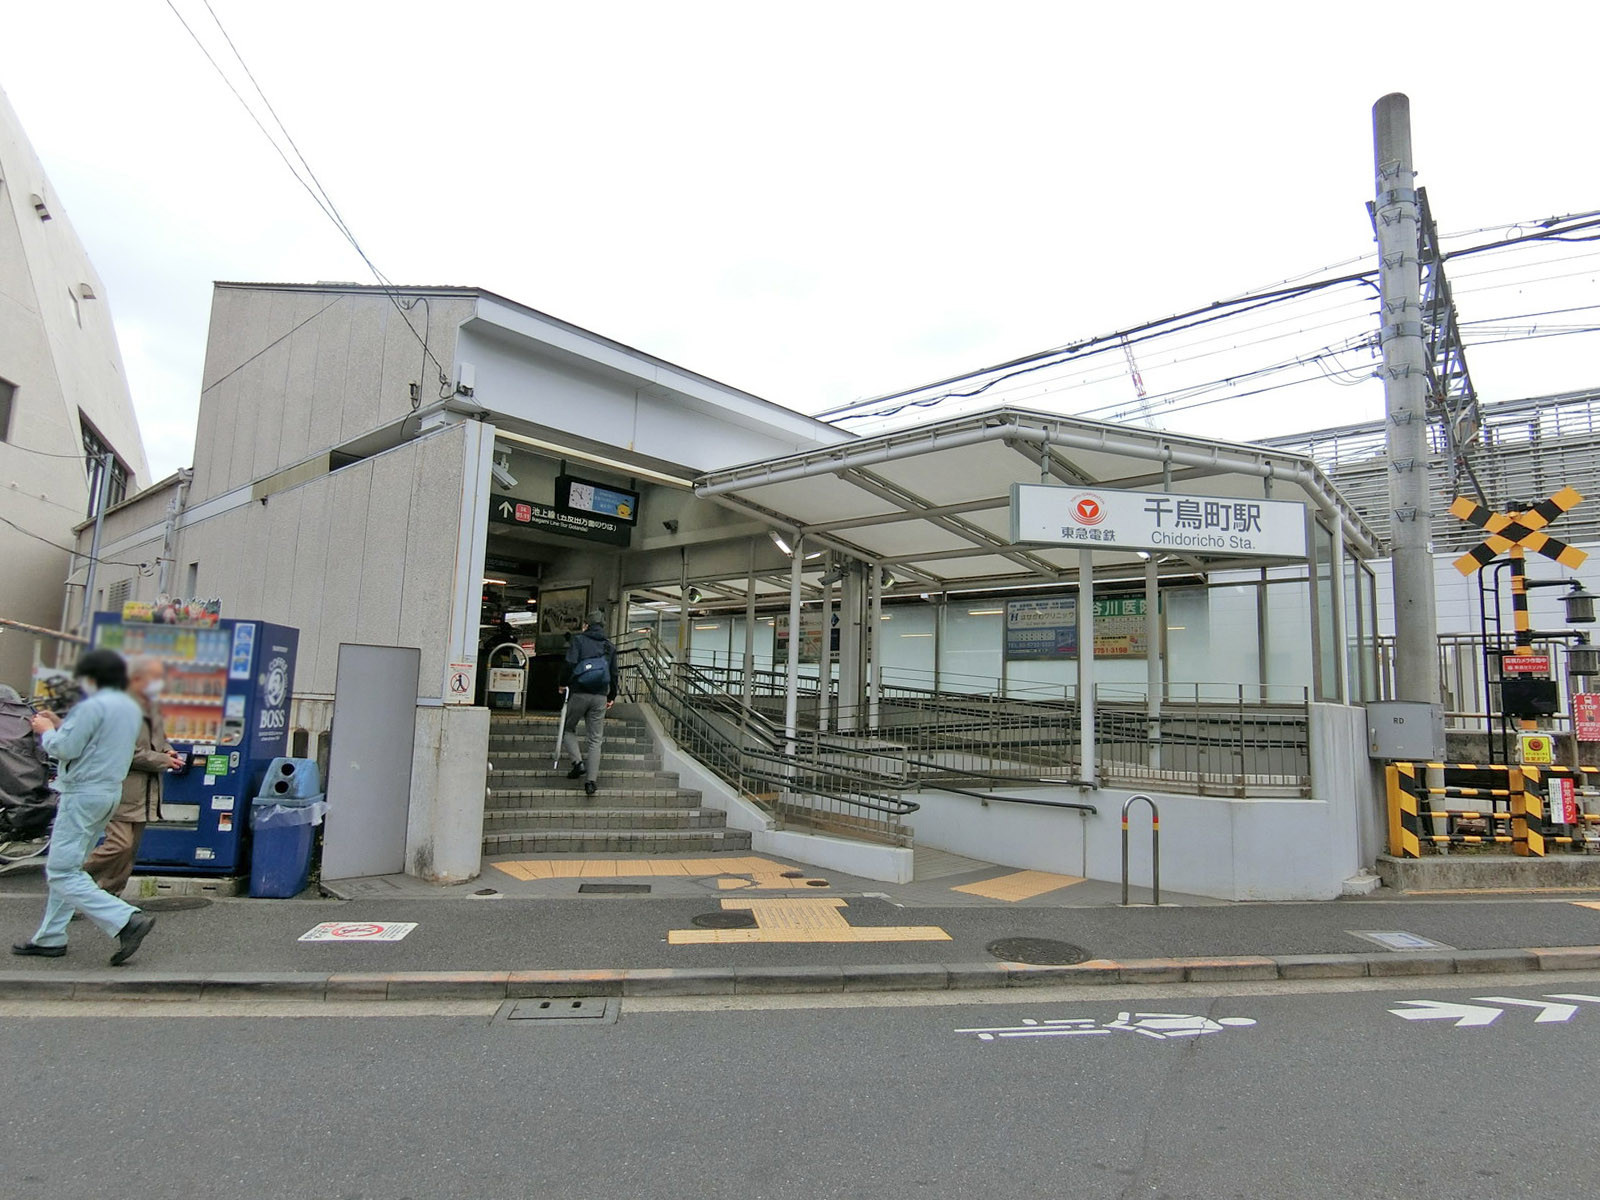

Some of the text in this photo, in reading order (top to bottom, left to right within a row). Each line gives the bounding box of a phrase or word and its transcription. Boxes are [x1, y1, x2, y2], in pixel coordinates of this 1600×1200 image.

[1143, 497, 1262, 533] 千鳥町駅
[1061, 526, 1116, 542] 東急電鉄
[1151, 530, 1256, 550] Chidorichō Sta.
[259, 709, 285, 729] BOSS
[1393, 717, 1405, 725] RD
[1563, 780, 1573, 821] 非常ボタン
